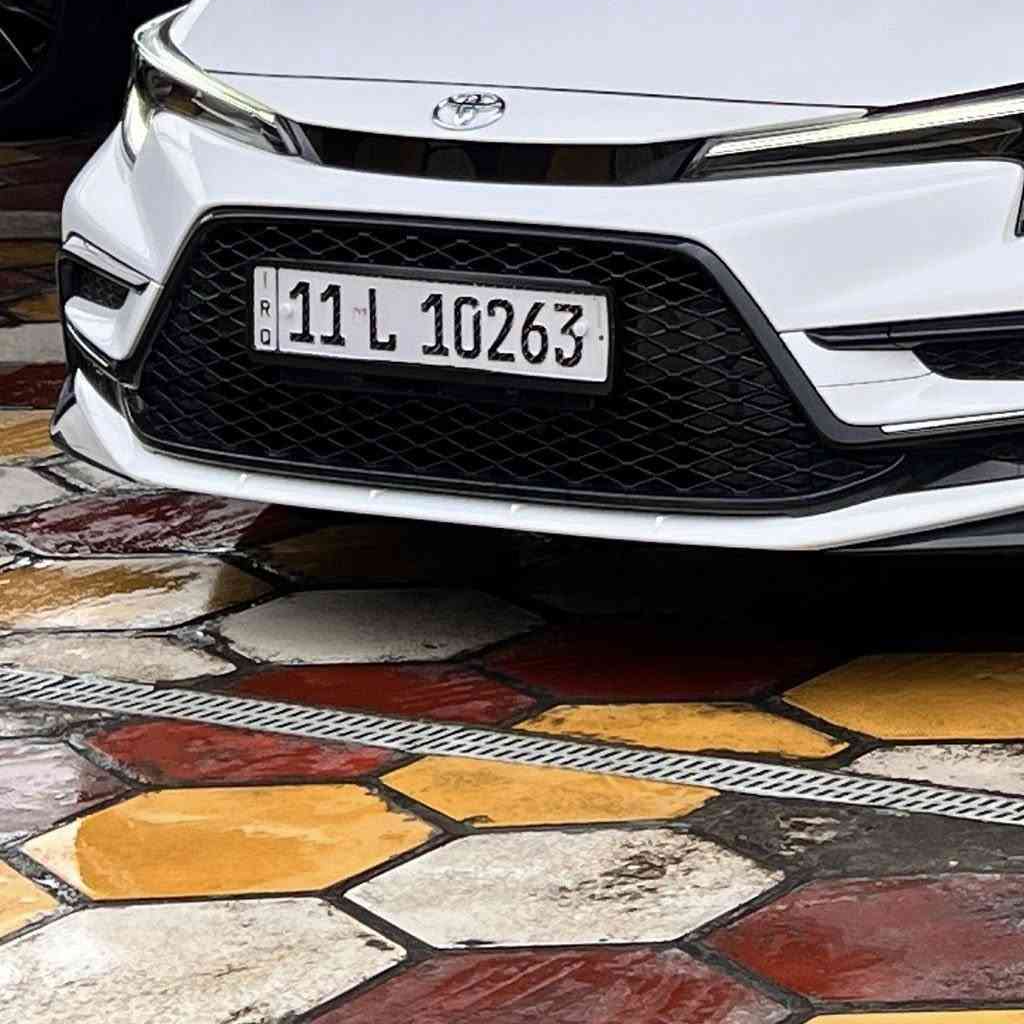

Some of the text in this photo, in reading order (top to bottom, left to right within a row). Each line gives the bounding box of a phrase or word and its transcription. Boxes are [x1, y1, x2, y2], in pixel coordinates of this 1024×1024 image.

[288, 280, 585, 369] 11 L 10263
